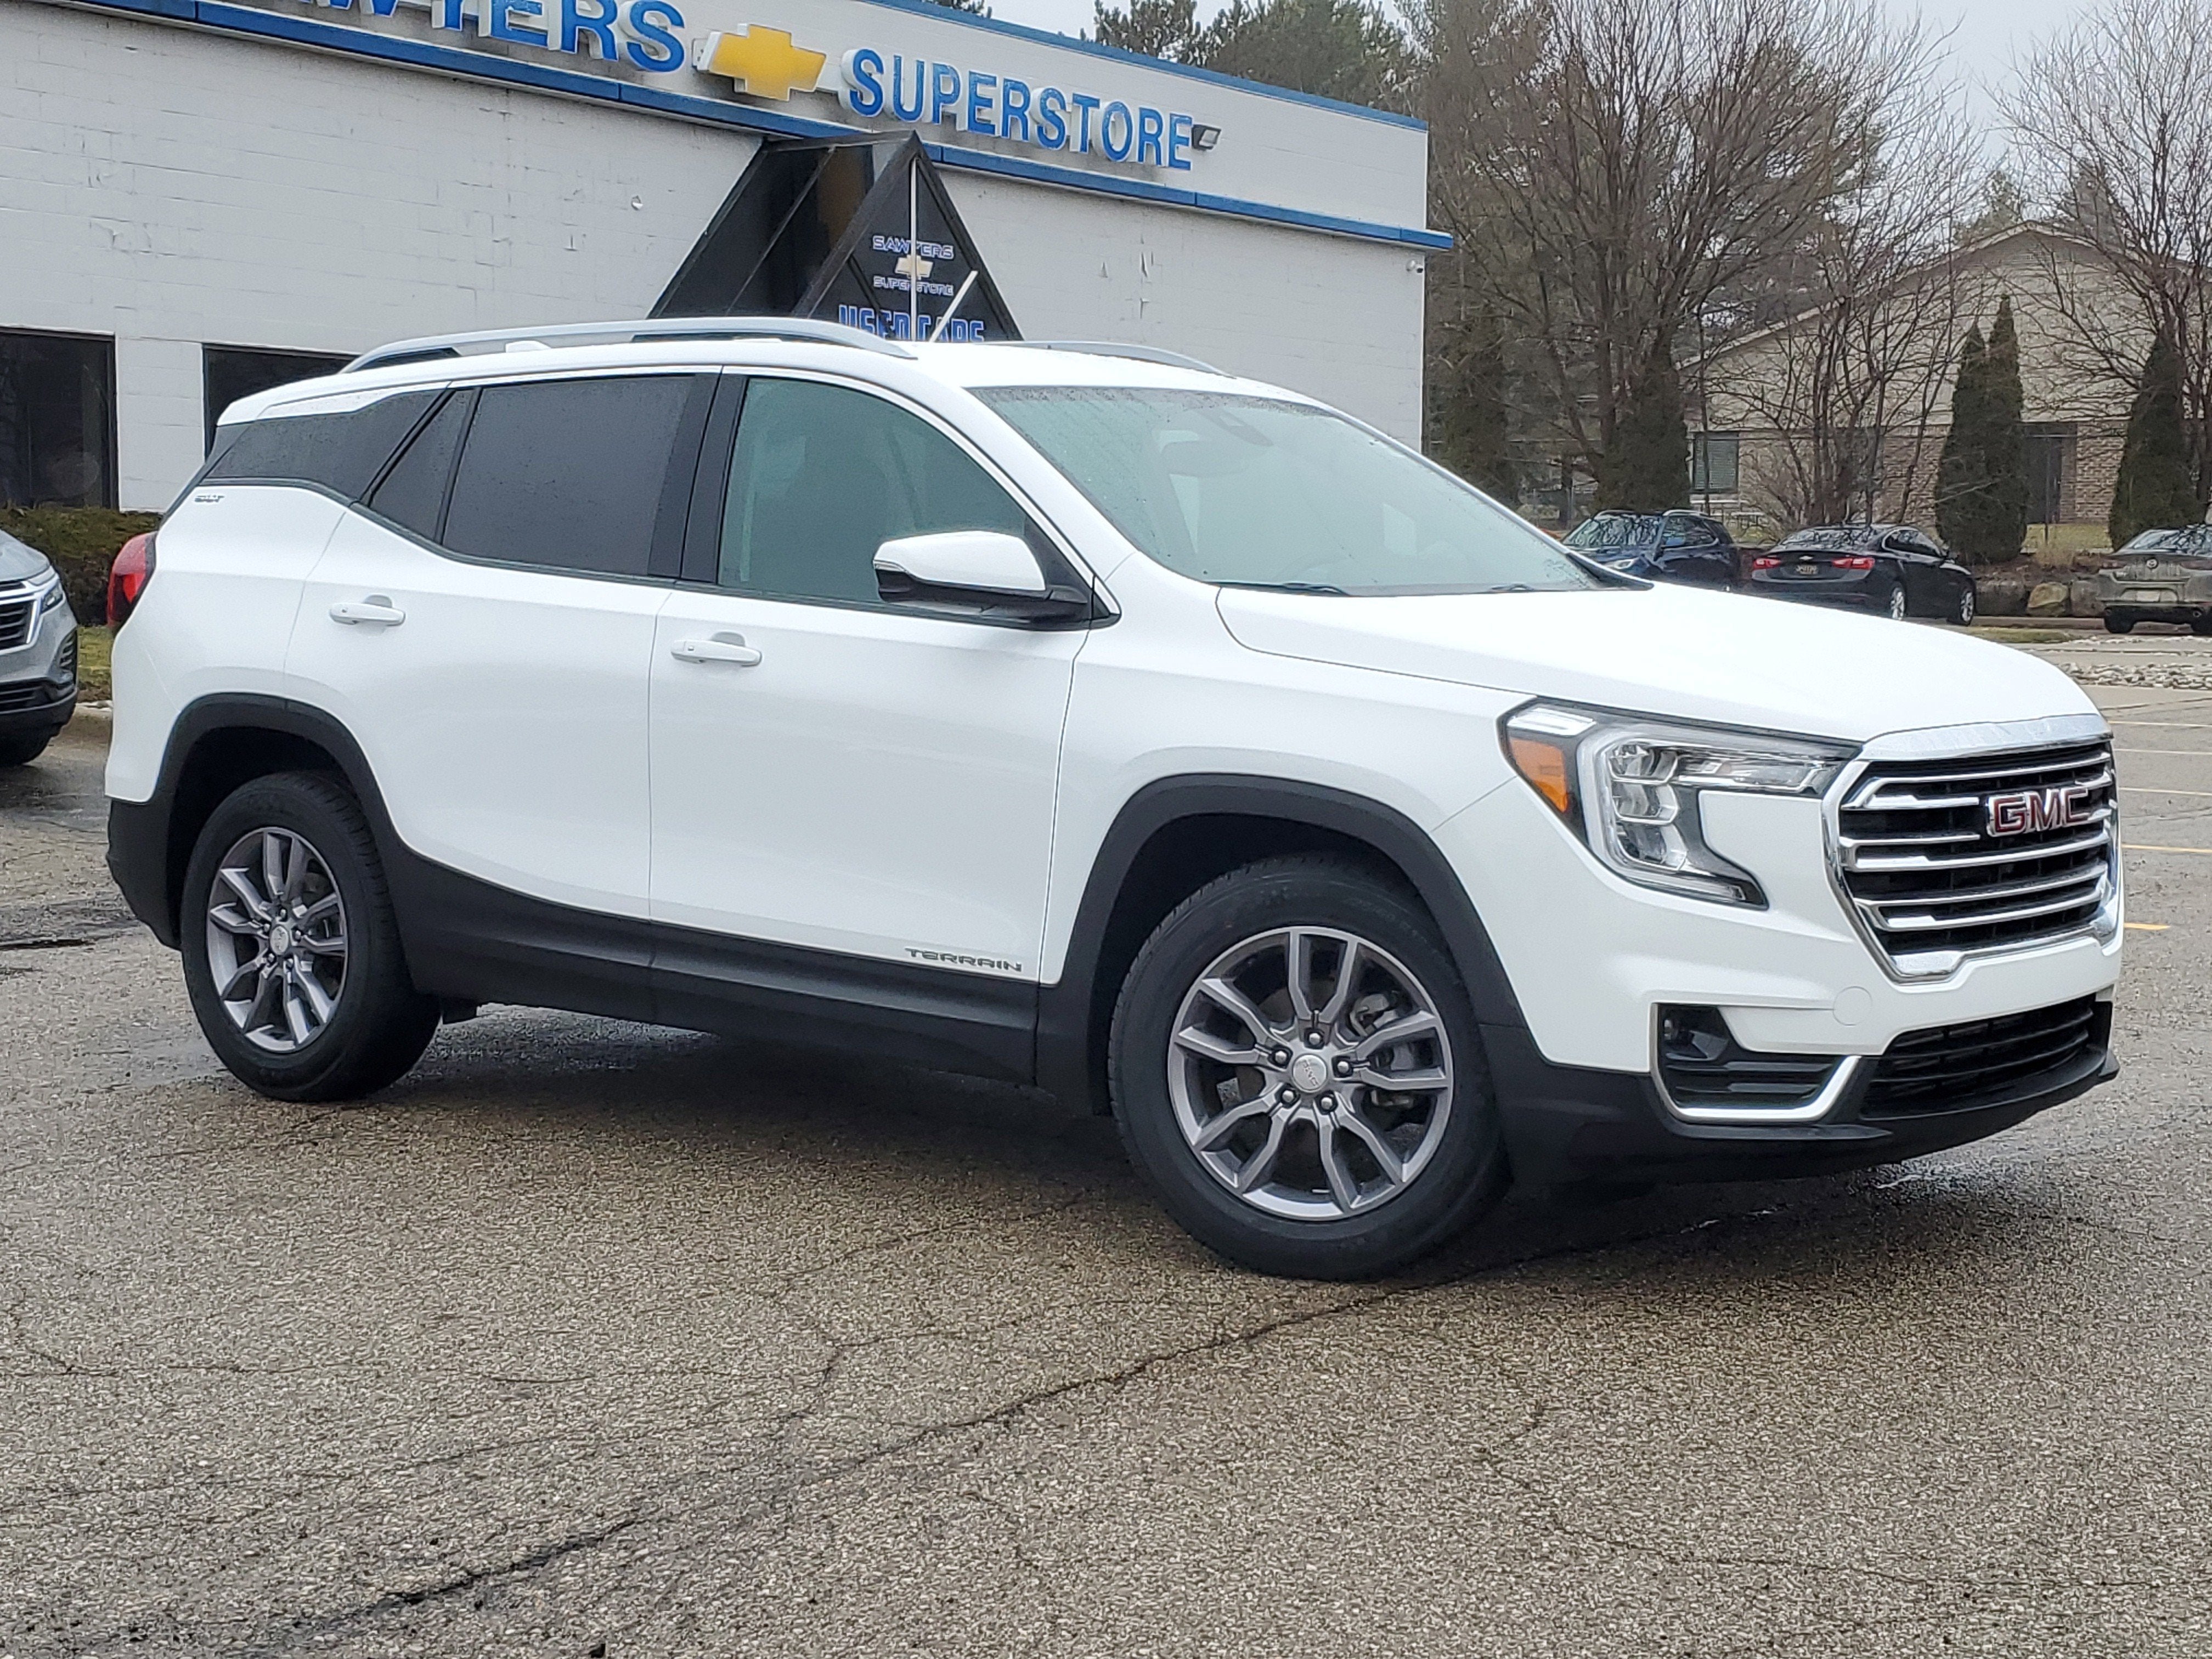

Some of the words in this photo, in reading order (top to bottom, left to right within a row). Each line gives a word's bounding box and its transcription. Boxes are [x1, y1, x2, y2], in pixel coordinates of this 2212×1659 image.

[328, 0, 685, 72] ERS
[851, 48, 1193, 171] SUPERSTORE
[1987, 788, 2090, 837] GMC
[905, 947, 1022, 972] TERRAIN
